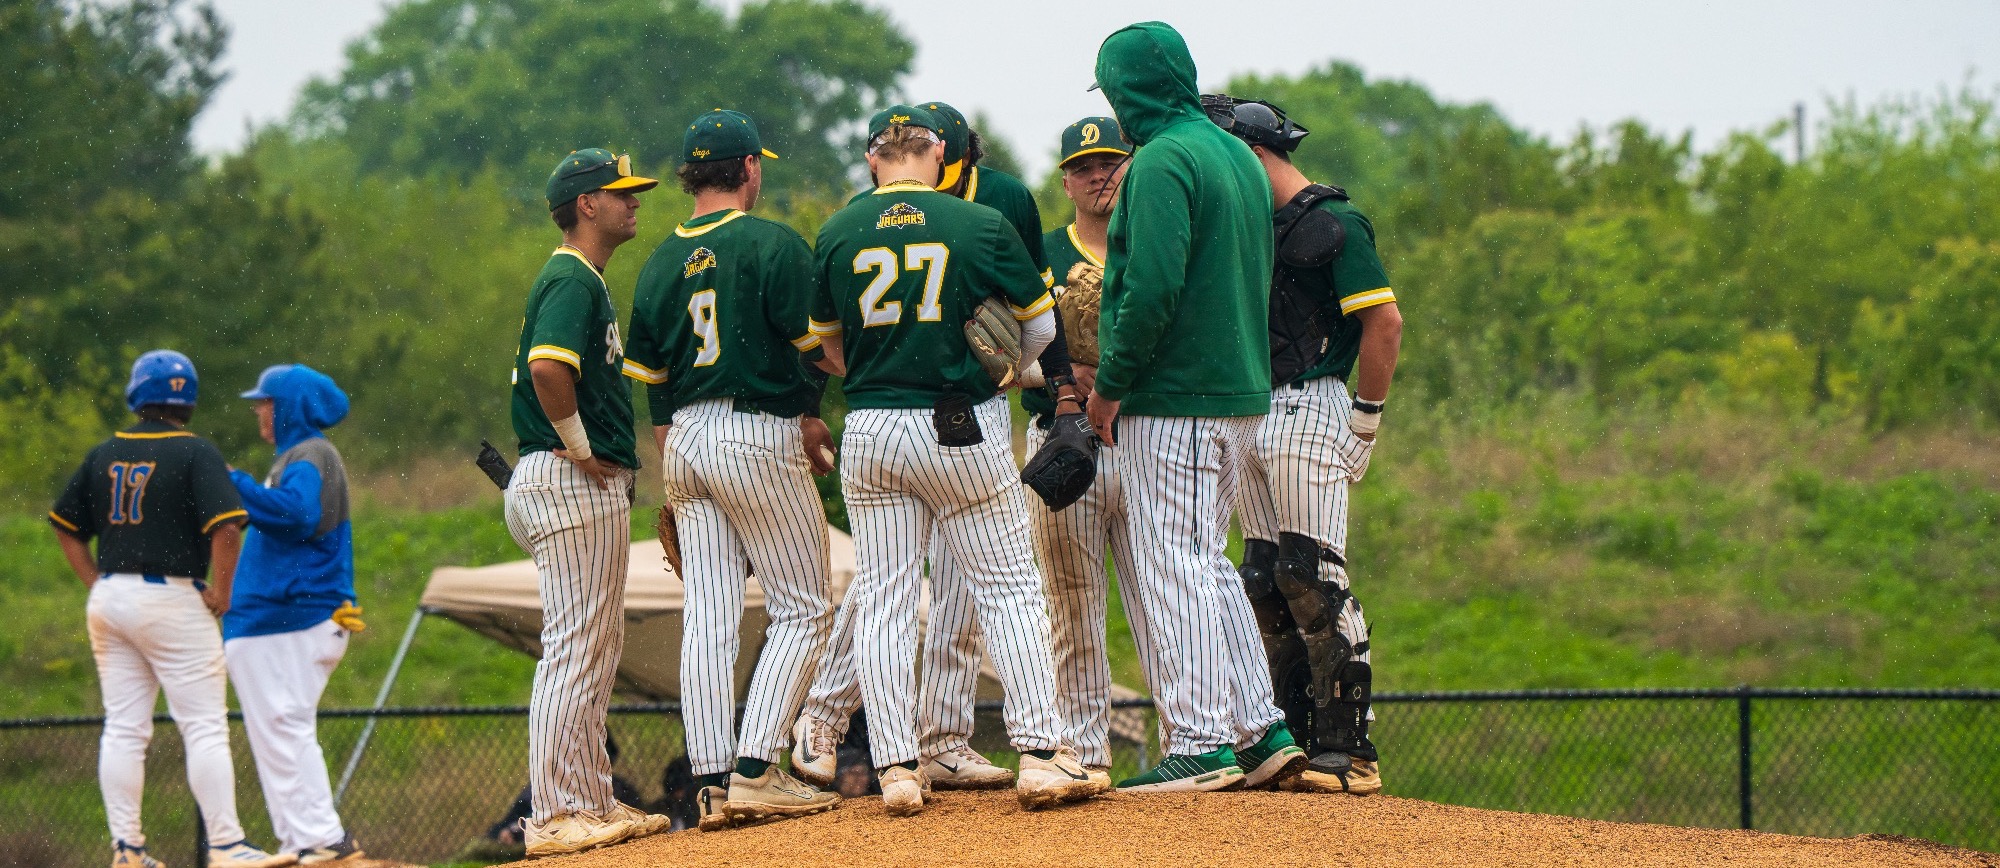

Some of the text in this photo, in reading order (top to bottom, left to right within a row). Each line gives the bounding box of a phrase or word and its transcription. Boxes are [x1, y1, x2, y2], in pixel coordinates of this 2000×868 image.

[890, 114, 910, 124] Jags
[1080, 123, 1100, 146] D
[692, 147, 711, 159] Jags
[876, 212, 926, 230] JAGUARS
[684, 255, 716, 278] JAGUARS
[853, 242, 950, 328] 27
[688, 288, 720, 367] 9
[169, 377, 186, 392] 17
[108, 460, 156, 525] 17
